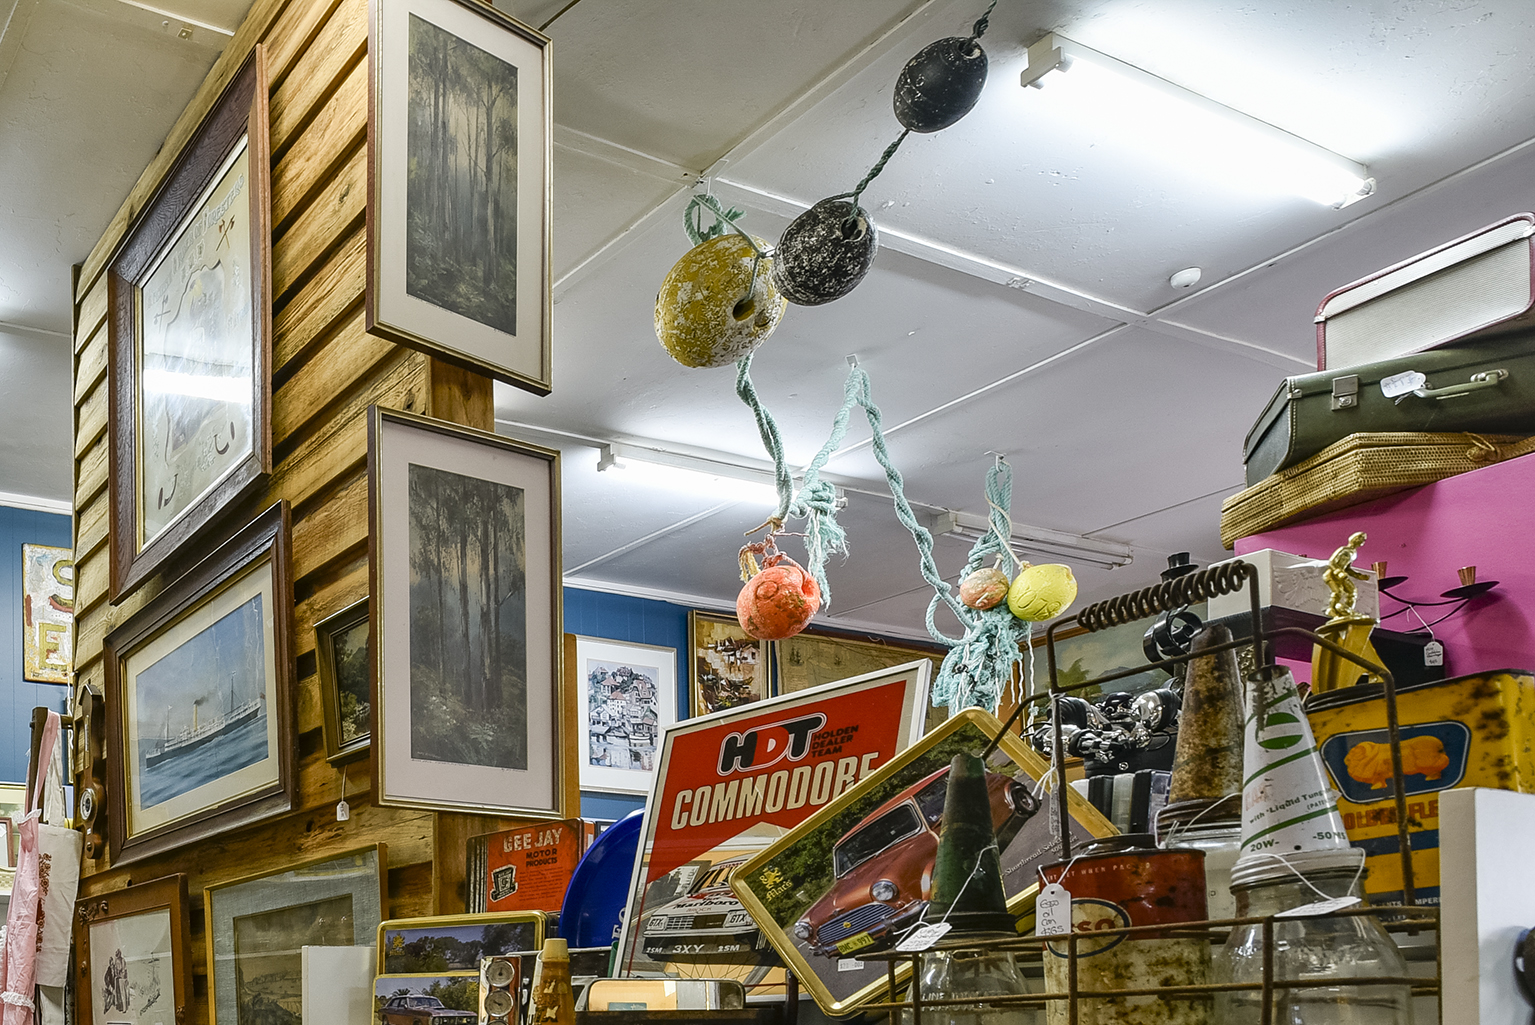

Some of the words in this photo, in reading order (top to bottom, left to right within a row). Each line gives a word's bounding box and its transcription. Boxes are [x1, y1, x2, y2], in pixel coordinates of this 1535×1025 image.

[812, 724, 859, 742] HOLDEN
[718, 713, 827, 776] HDT
[811, 733, 854, 750] DEALER
[811, 745, 843, 759] TEAM
[1249, 810, 1265, 825] with
[534, 827, 563, 848] JAY
[526, 848, 557, 859] MOTOR
[526, 857, 558, 867] PRODUCTS
[673, 900, 739, 909] Marlboro
[1042, 908, 1054, 918] oil
[649, 918, 662, 927] GTX
[730, 914, 746, 924] GTX
[1041, 918, 1056, 927] can
[672, 944, 704, 954] 3XY
[718, 944, 740, 952] 2SM
